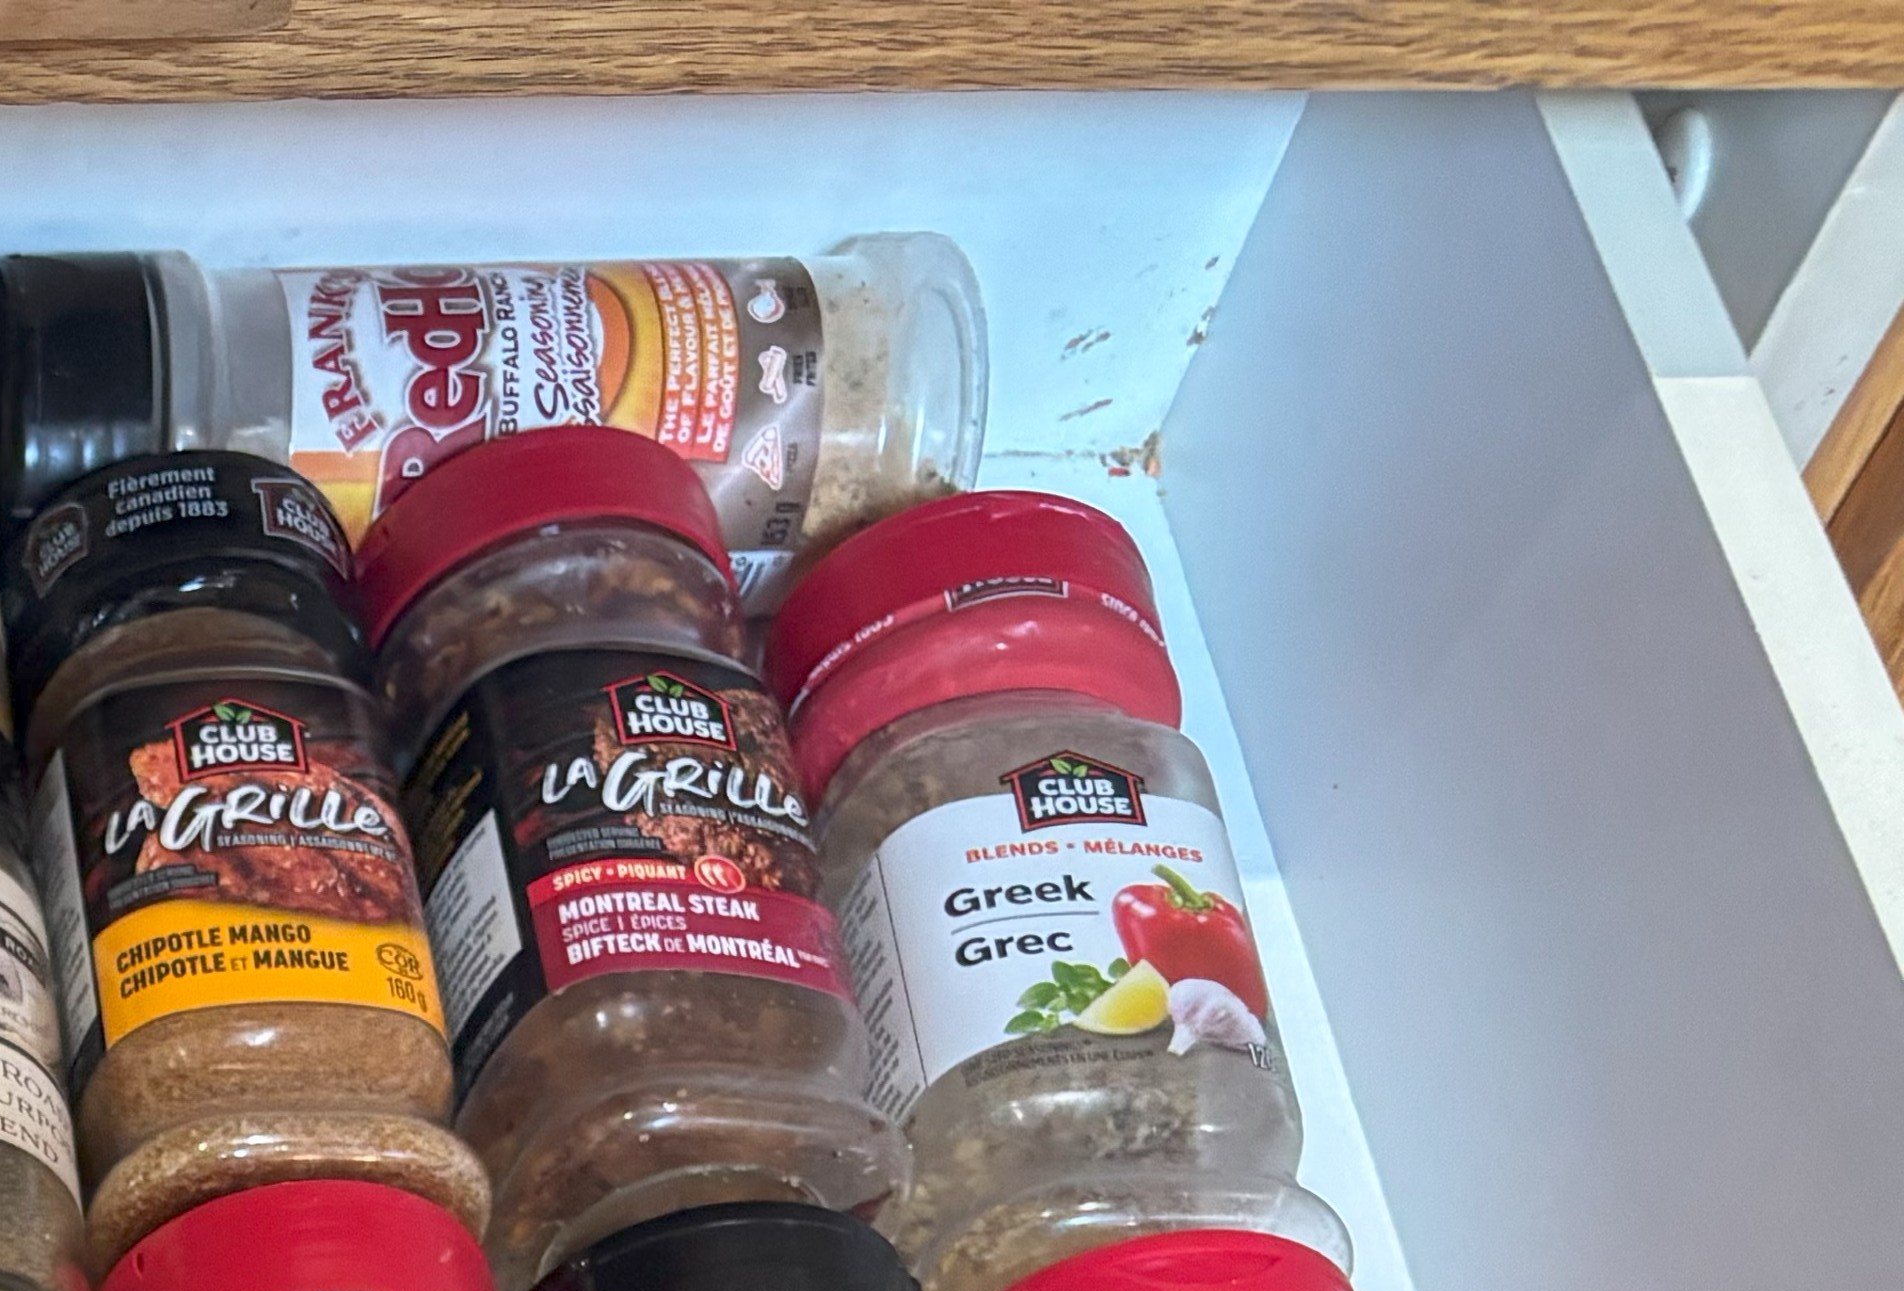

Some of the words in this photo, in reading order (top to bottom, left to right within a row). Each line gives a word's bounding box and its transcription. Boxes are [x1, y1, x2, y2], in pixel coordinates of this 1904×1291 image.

[115, 485, 212, 514] canadien
[105, 506, 175, 537] depuis
[179, 501, 229, 520] 1883
[634, 694, 709, 719] CLUB
[199, 724, 278, 745] CLUB
[627, 712, 727, 742] HOUSE
[191, 743, 294, 769] HOUSE
[1037, 775, 1115, 797] CLUB
[1030, 794, 1133, 819] HOUSE
[551, 868, 602, 892] SPICY
[616, 864, 687, 881] PIQUANT
[557, 891, 686, 925] MONTREAL
[688, 894, 761, 922] STEAK
[943, 874, 1096, 918] Greek
[561, 917, 610, 943] SPICE
[630, 912, 688, 932] ÉPICES
[116, 925, 223, 974] CHIPOTLE
[227, 923, 311, 946] MANGO
[567, 933, 661, 966] BIFTECK
[663, 936, 685, 953] DE
[687, 932, 801, 969] MONTRÉAL
[954, 929, 1074, 969] Grec
[119, 952, 225, 1000] CHIPOTLE
[230, 957, 248, 972] ET
[252, 949, 349, 973] MANGUE
